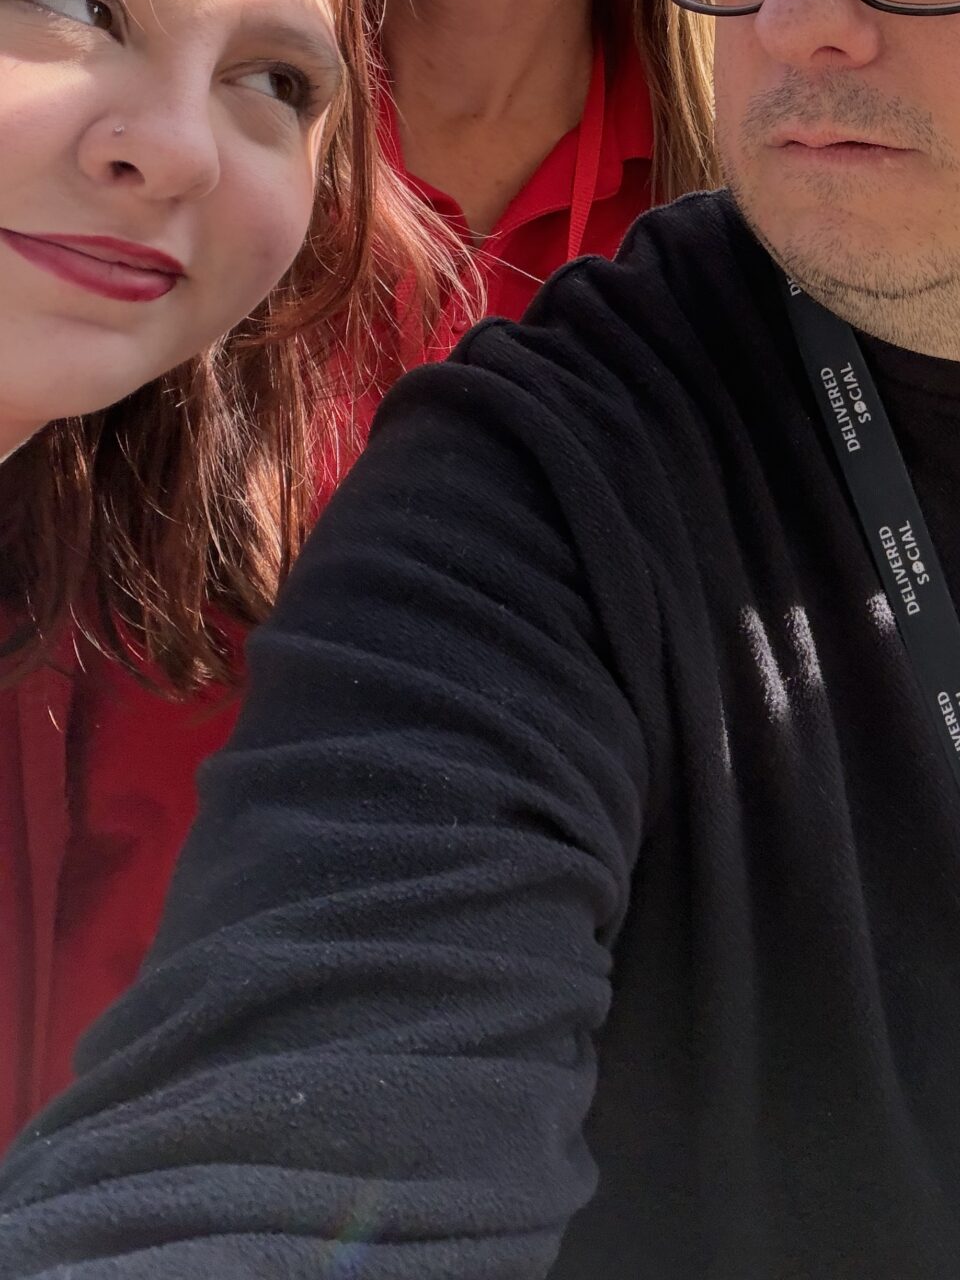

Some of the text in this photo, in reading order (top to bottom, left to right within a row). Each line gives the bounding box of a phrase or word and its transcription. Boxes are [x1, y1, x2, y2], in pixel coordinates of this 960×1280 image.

[819, 367, 861, 452] DELIVERED
[840, 361, 872, 424] SOCIAL
[878, 526, 921, 616] DELIVERED
[898, 520, 930, 586] SOCIAL
